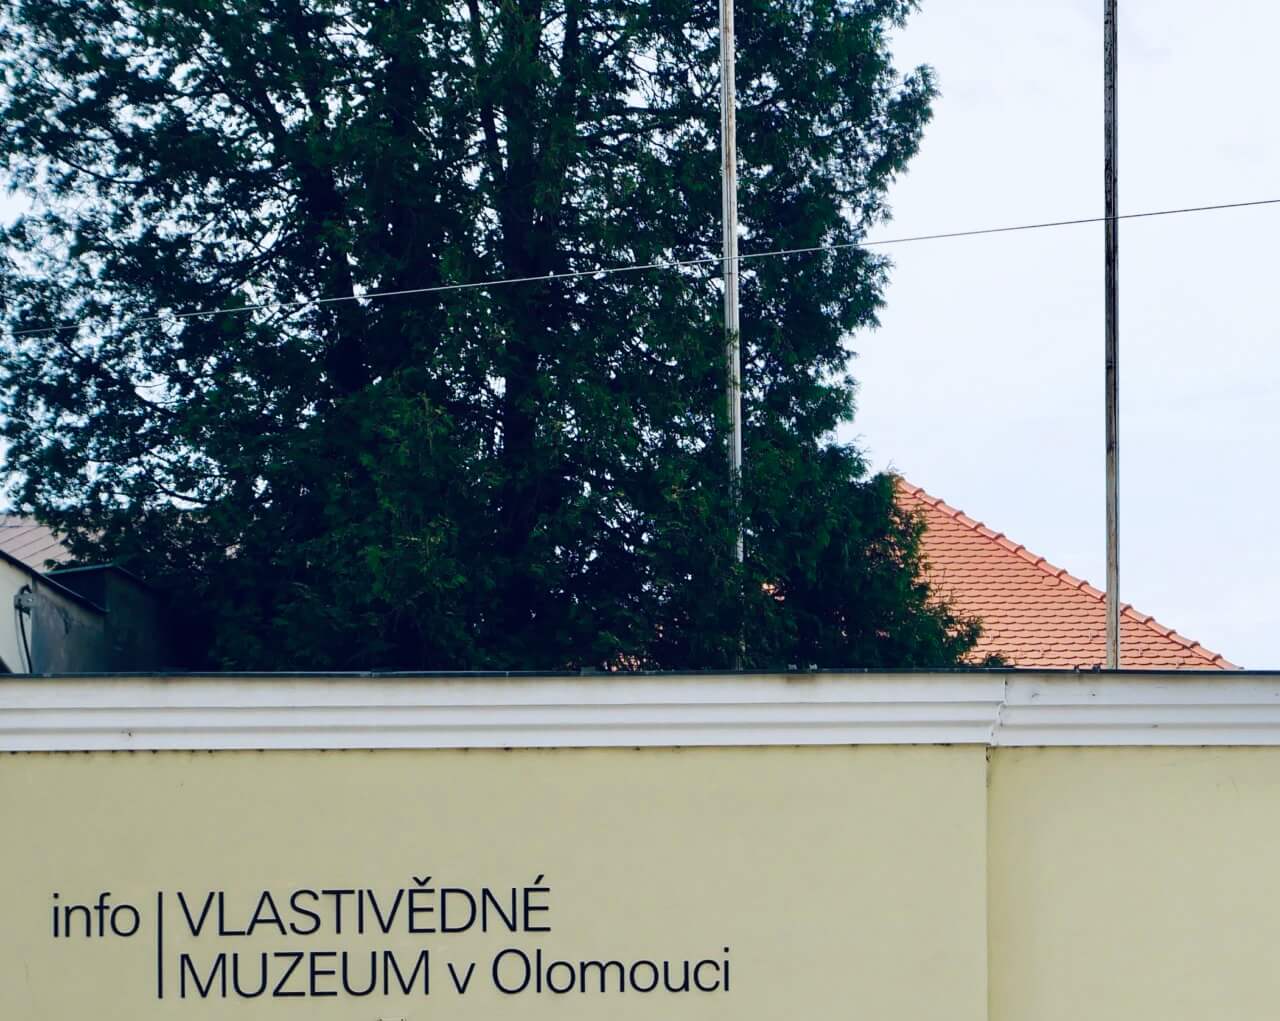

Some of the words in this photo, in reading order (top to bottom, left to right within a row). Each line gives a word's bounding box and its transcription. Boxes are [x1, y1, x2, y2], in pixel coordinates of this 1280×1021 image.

[52, 893, 141, 938] info
[177, 875, 552, 937] VLASTIVĚDNÉ
[179, 949, 430, 999] MUZEUM
[447, 961, 476, 995] v
[491, 947, 731, 995] Olomouci
